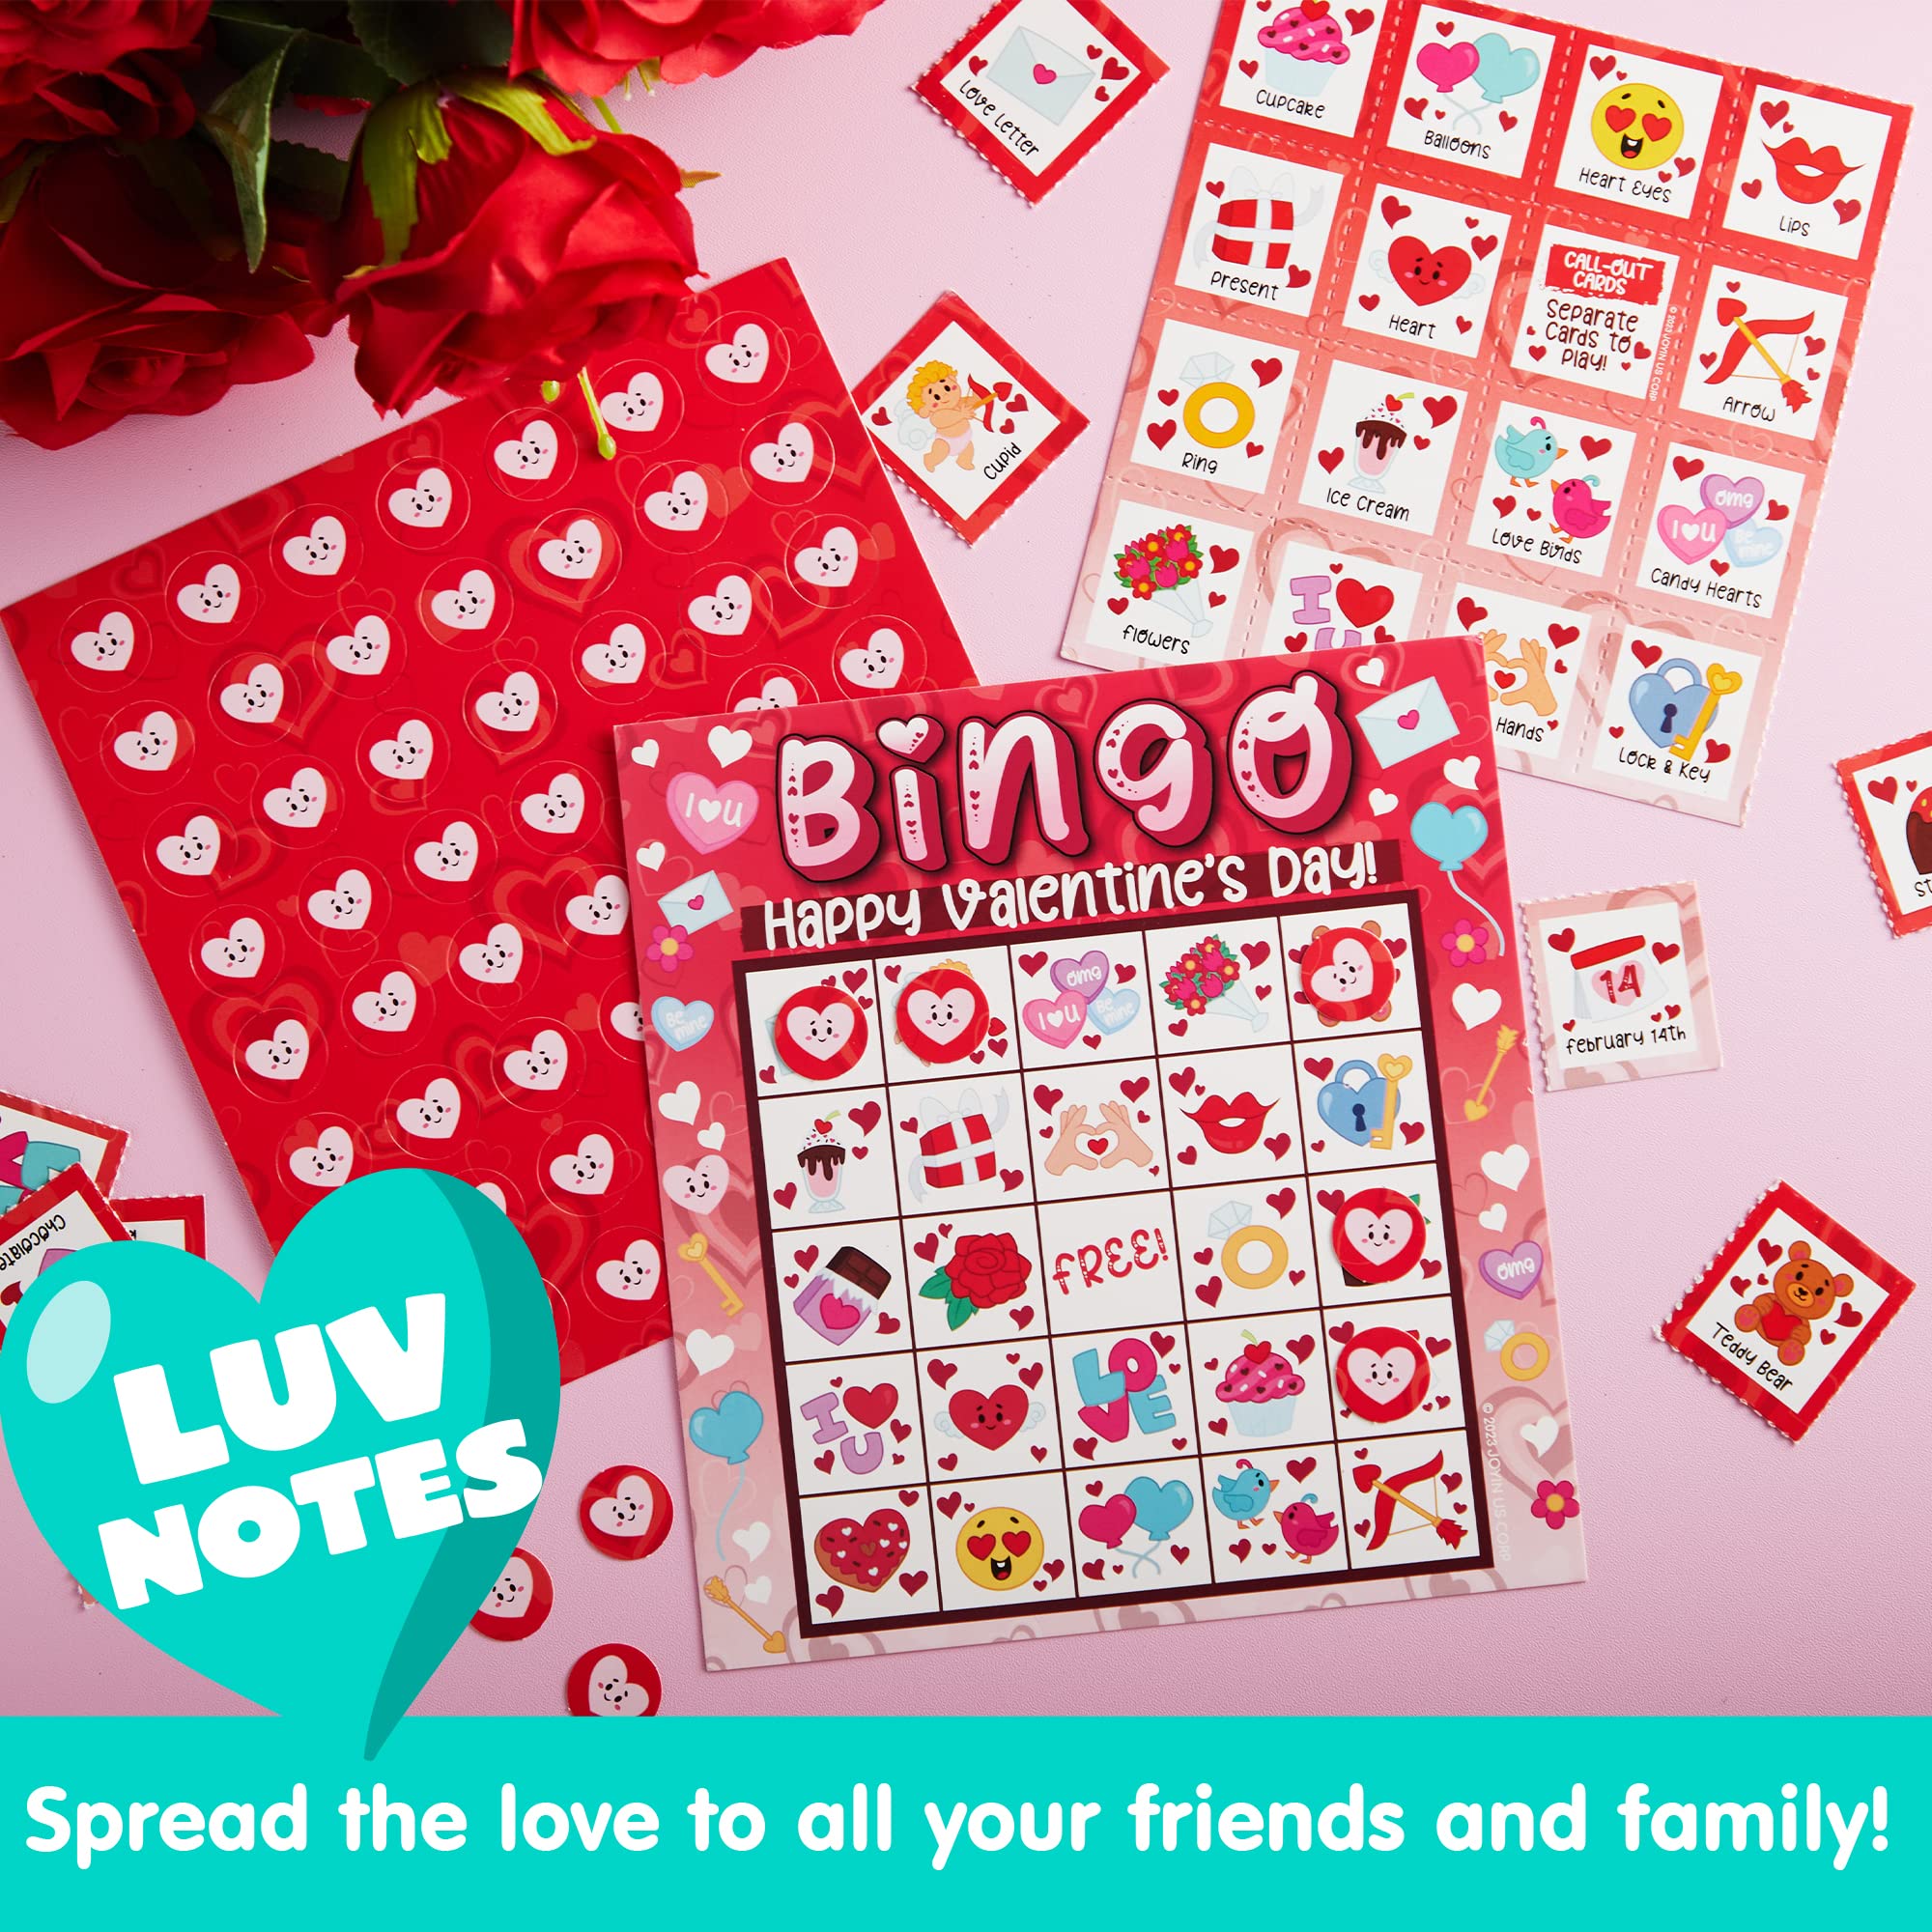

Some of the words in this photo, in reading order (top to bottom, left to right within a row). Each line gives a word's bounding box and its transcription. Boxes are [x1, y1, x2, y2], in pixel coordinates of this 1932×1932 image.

[959, 79, 996, 116] Love
[994, 113, 1039, 156] Letter
[1256, 89, 1325, 120] Cupcake
[1424, 129, 1491, 159] Balloons
[1578, 168, 1626, 193] Heart
[1631, 181, 1672, 204] Eyes
[1779, 214, 1810, 238] Lips
[1564, 251, 1654, 281] CALL-OUT
[1573, 271, 1628, 295] CARDS
[1389, 314, 1435, 340] Heart
[1547, 298, 1638, 332] Separate
[1546, 322, 1599, 348] Cards
[1609, 331, 1632, 354] to
[1660, 333, 1673, 361] JOYIN
[1655, 362, 1665, 375] US
[1648, 377, 1662, 402] CORP
[1722, 396, 1776, 422] Arrow
[982, 442, 1022, 481] Cupid
[1182, 452, 1218, 475] Ring
[1326, 488, 1350, 507] Ice
[1356, 496, 1409, 522] Cream
[1492, 528, 1534, 552] Love
[1540, 541, 1582, 564] Birds
[1290, 576, 1332, 625] I
[1651, 568, 1701, 592] Candy
[1706, 582, 1762, 609] Hearts
[1495, 716, 1544, 743] Hands
[1619, 747, 1657, 770] Lock
[1663, 759, 1673, 774] &
[1679, 761, 1711, 782] Key
[763, 888, 922, 952] Happy
[943, 853, 1247, 930] Valentine's
[1269, 840, 1378, 899] Day!
[1600, 964, 1641, 1004] 14
[1651, 1025, 1687, 1043] 14th
[0, 1213, 66, 1271] Chocolate
[1716, 1321, 1758, 1366] Teddy
[1756, 1360, 1793, 1392] Bear
[800, 1391, 849, 1445] I
[1483, 1417, 1498, 1447] 2023
[839, 1431, 884, 1475] U
[1487, 1449, 1503, 1494] JOYIN
[1492, 1497, 1507, 1519] US
[1496, 1522, 1512, 1562] CORP
